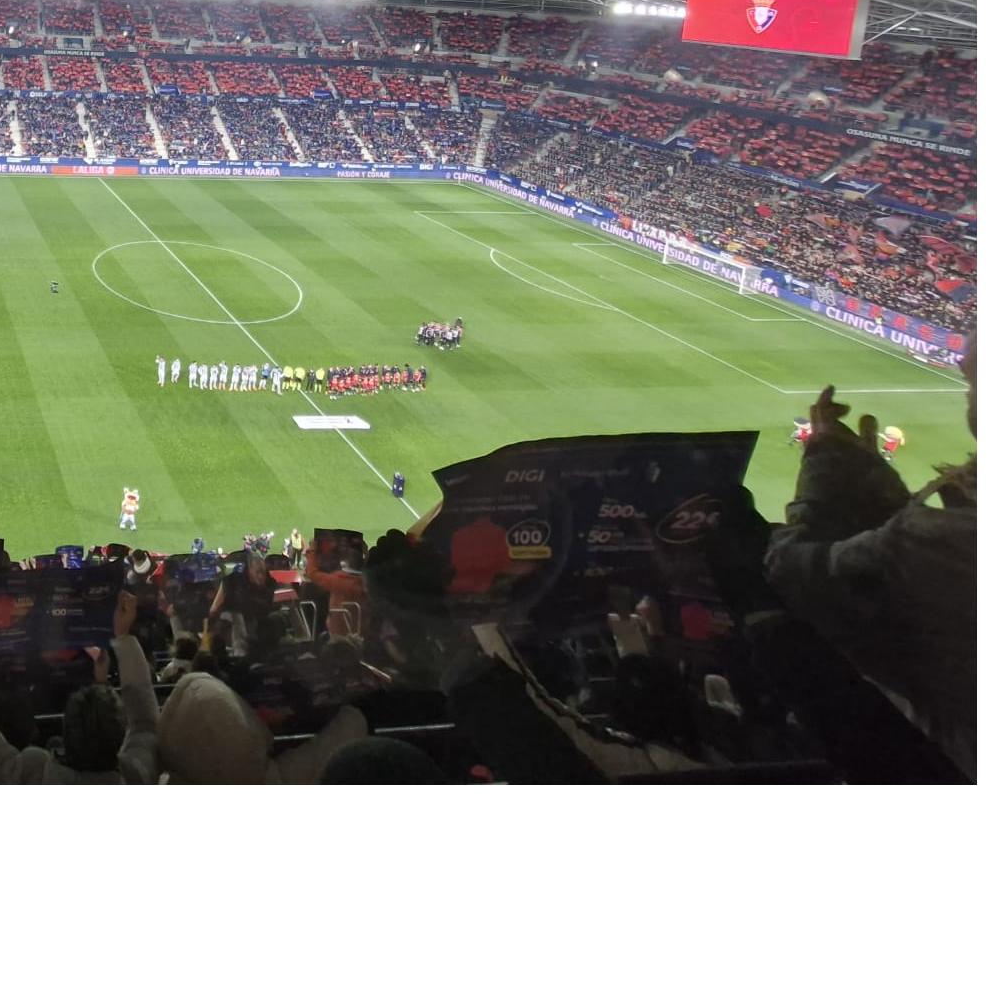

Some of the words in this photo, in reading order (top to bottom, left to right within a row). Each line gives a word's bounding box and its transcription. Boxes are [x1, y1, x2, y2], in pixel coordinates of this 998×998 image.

[846, 128, 888, 142] OSASUNA
[889, 135, 923, 148] NUNCA
[925, 142, 937, 150] SE
[9, 165, 48, 173] NAVARRA
[73, 166, 104, 174] LALIGA
[232, 168, 243, 176] DE
[528, 194, 538, 204] DE
[636, 233, 700, 267] UNIVESIDAD
[702, 258, 718, 274] DE
[720, 265, 779, 299] NAVRRA
[825, 305, 886, 339] CLINICA
[505, 469, 546, 483] DIGI
[598, 504, 635, 518] 500
[512, 530, 543, 545] 100
[587, 530, 612, 544] 50
